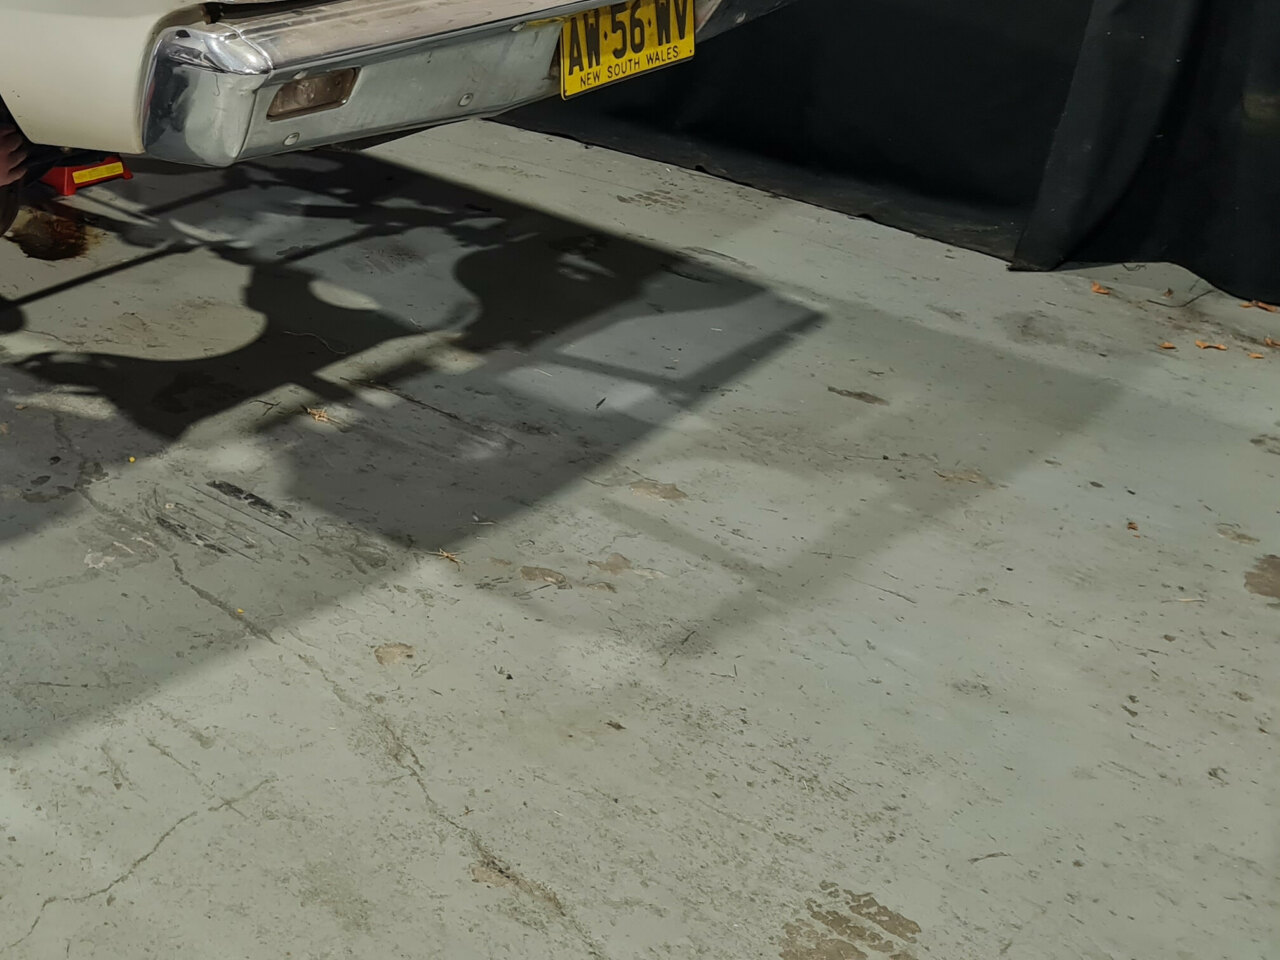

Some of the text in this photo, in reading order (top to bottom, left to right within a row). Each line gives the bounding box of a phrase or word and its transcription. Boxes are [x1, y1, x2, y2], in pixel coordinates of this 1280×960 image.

[580, 46, 679, 89] NEW SOUTH WALES
